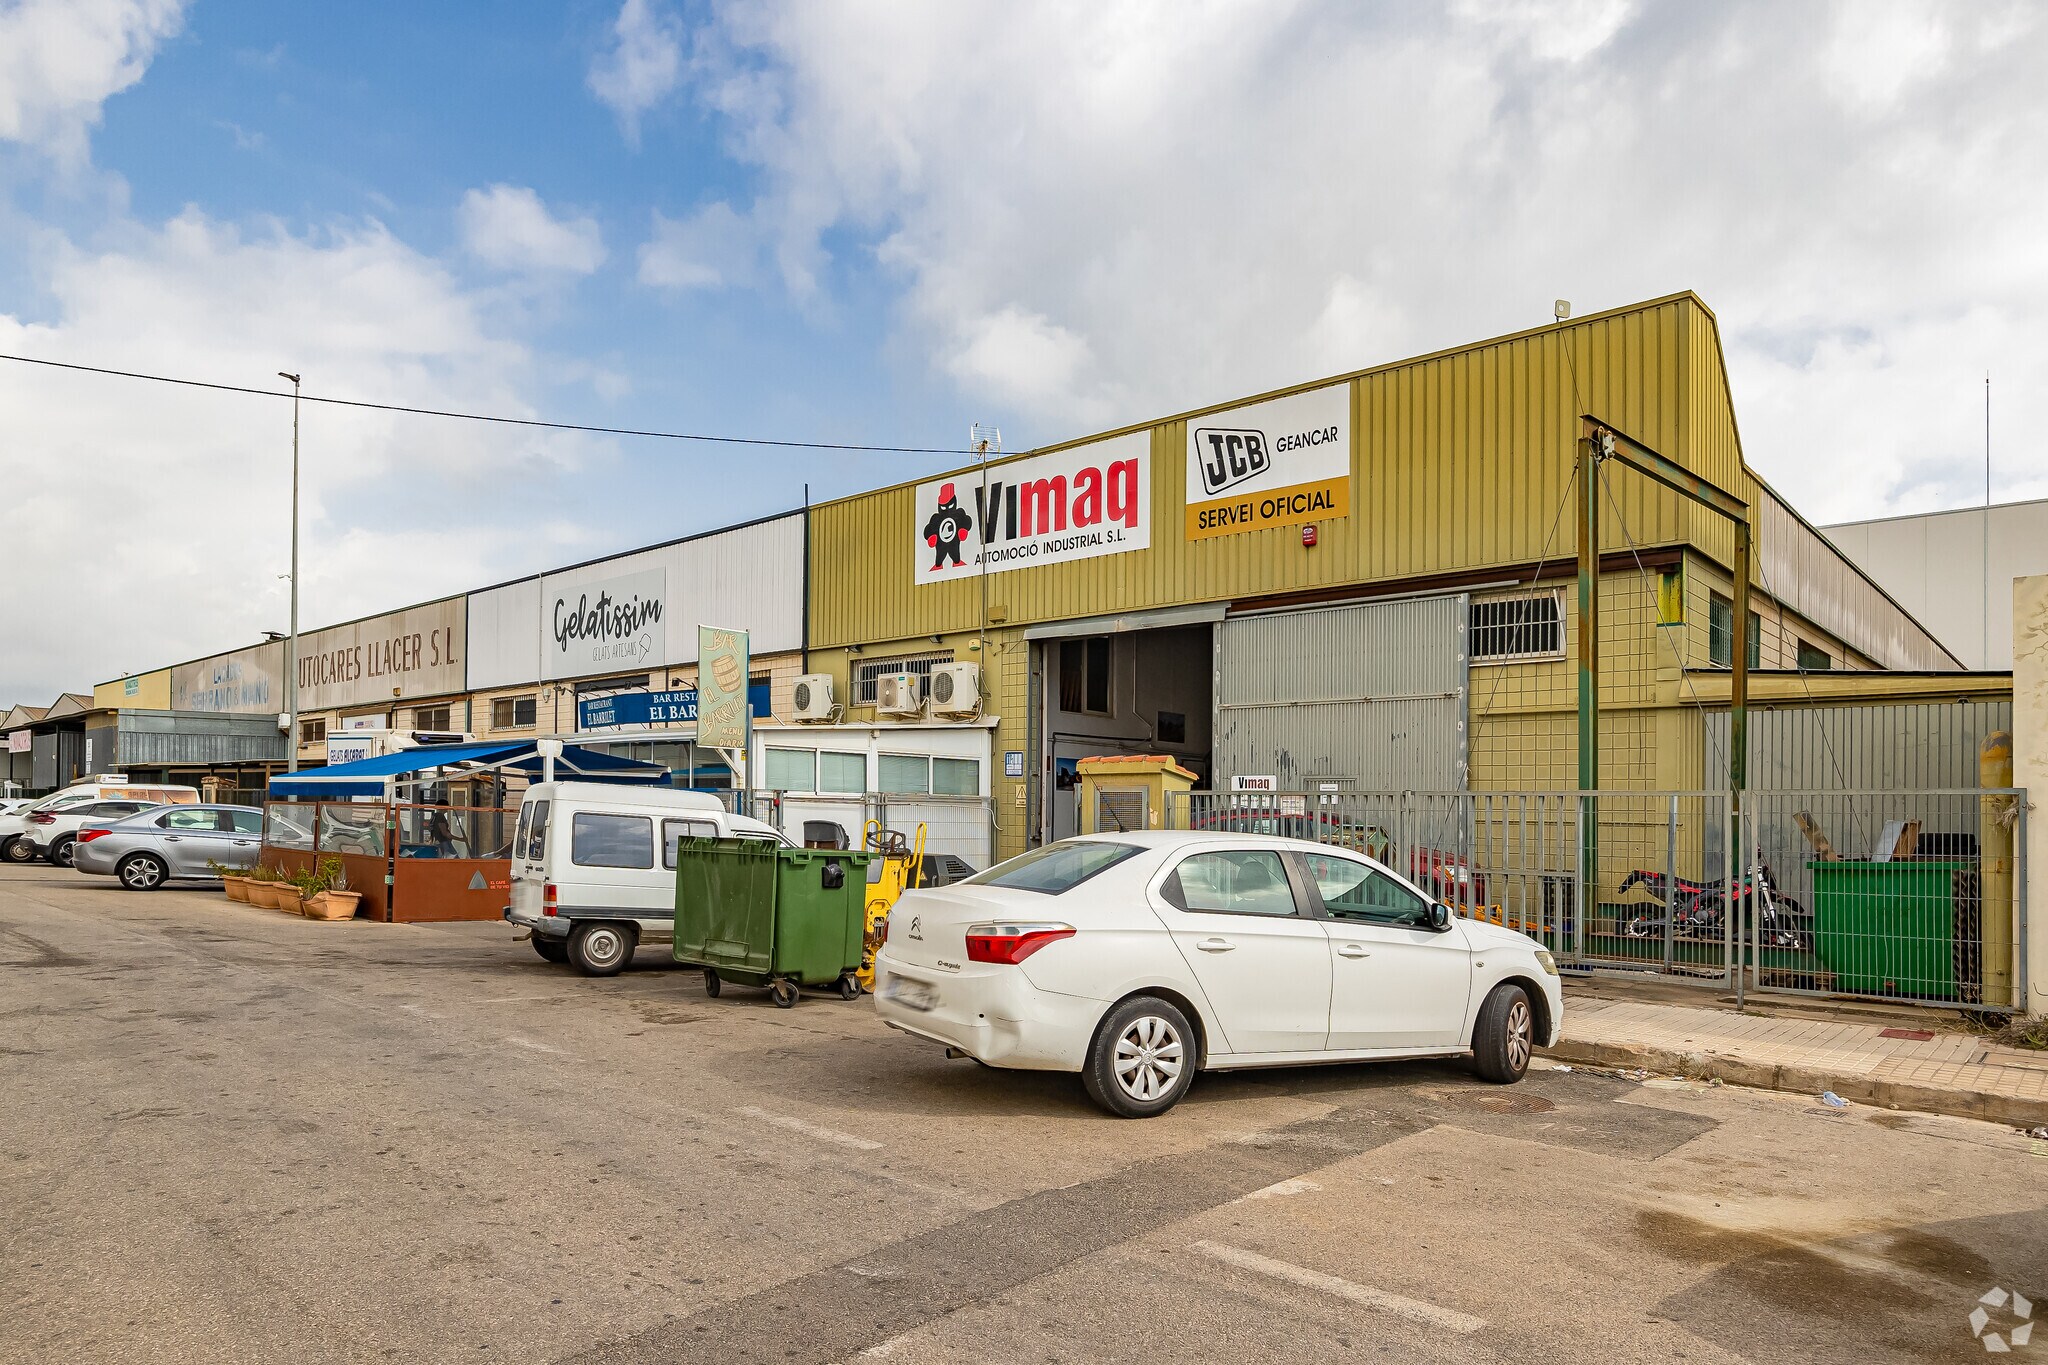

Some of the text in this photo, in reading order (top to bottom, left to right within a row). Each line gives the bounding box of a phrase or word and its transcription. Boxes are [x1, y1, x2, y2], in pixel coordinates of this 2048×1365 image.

[1276, 426, 1338, 453] GEANCAR
[1206, 434, 1265, 487] JCB
[1198, 489, 1335, 530] SERVEI OFICIAL
[974, 530, 1127, 566] AUTOMOCIÓ INDUSTRIAL S.L.
[592, 641, 637, 662] GELATS ARTESANS
[703, 629, 739, 655] BAR
[298, 645, 362, 689] UTOCARES
[367, 633, 422, 678] LLACER
[653, 693, 672, 704] BAR
[703, 685, 720, 705] EL
[649, 704, 698, 720] EL BAR
